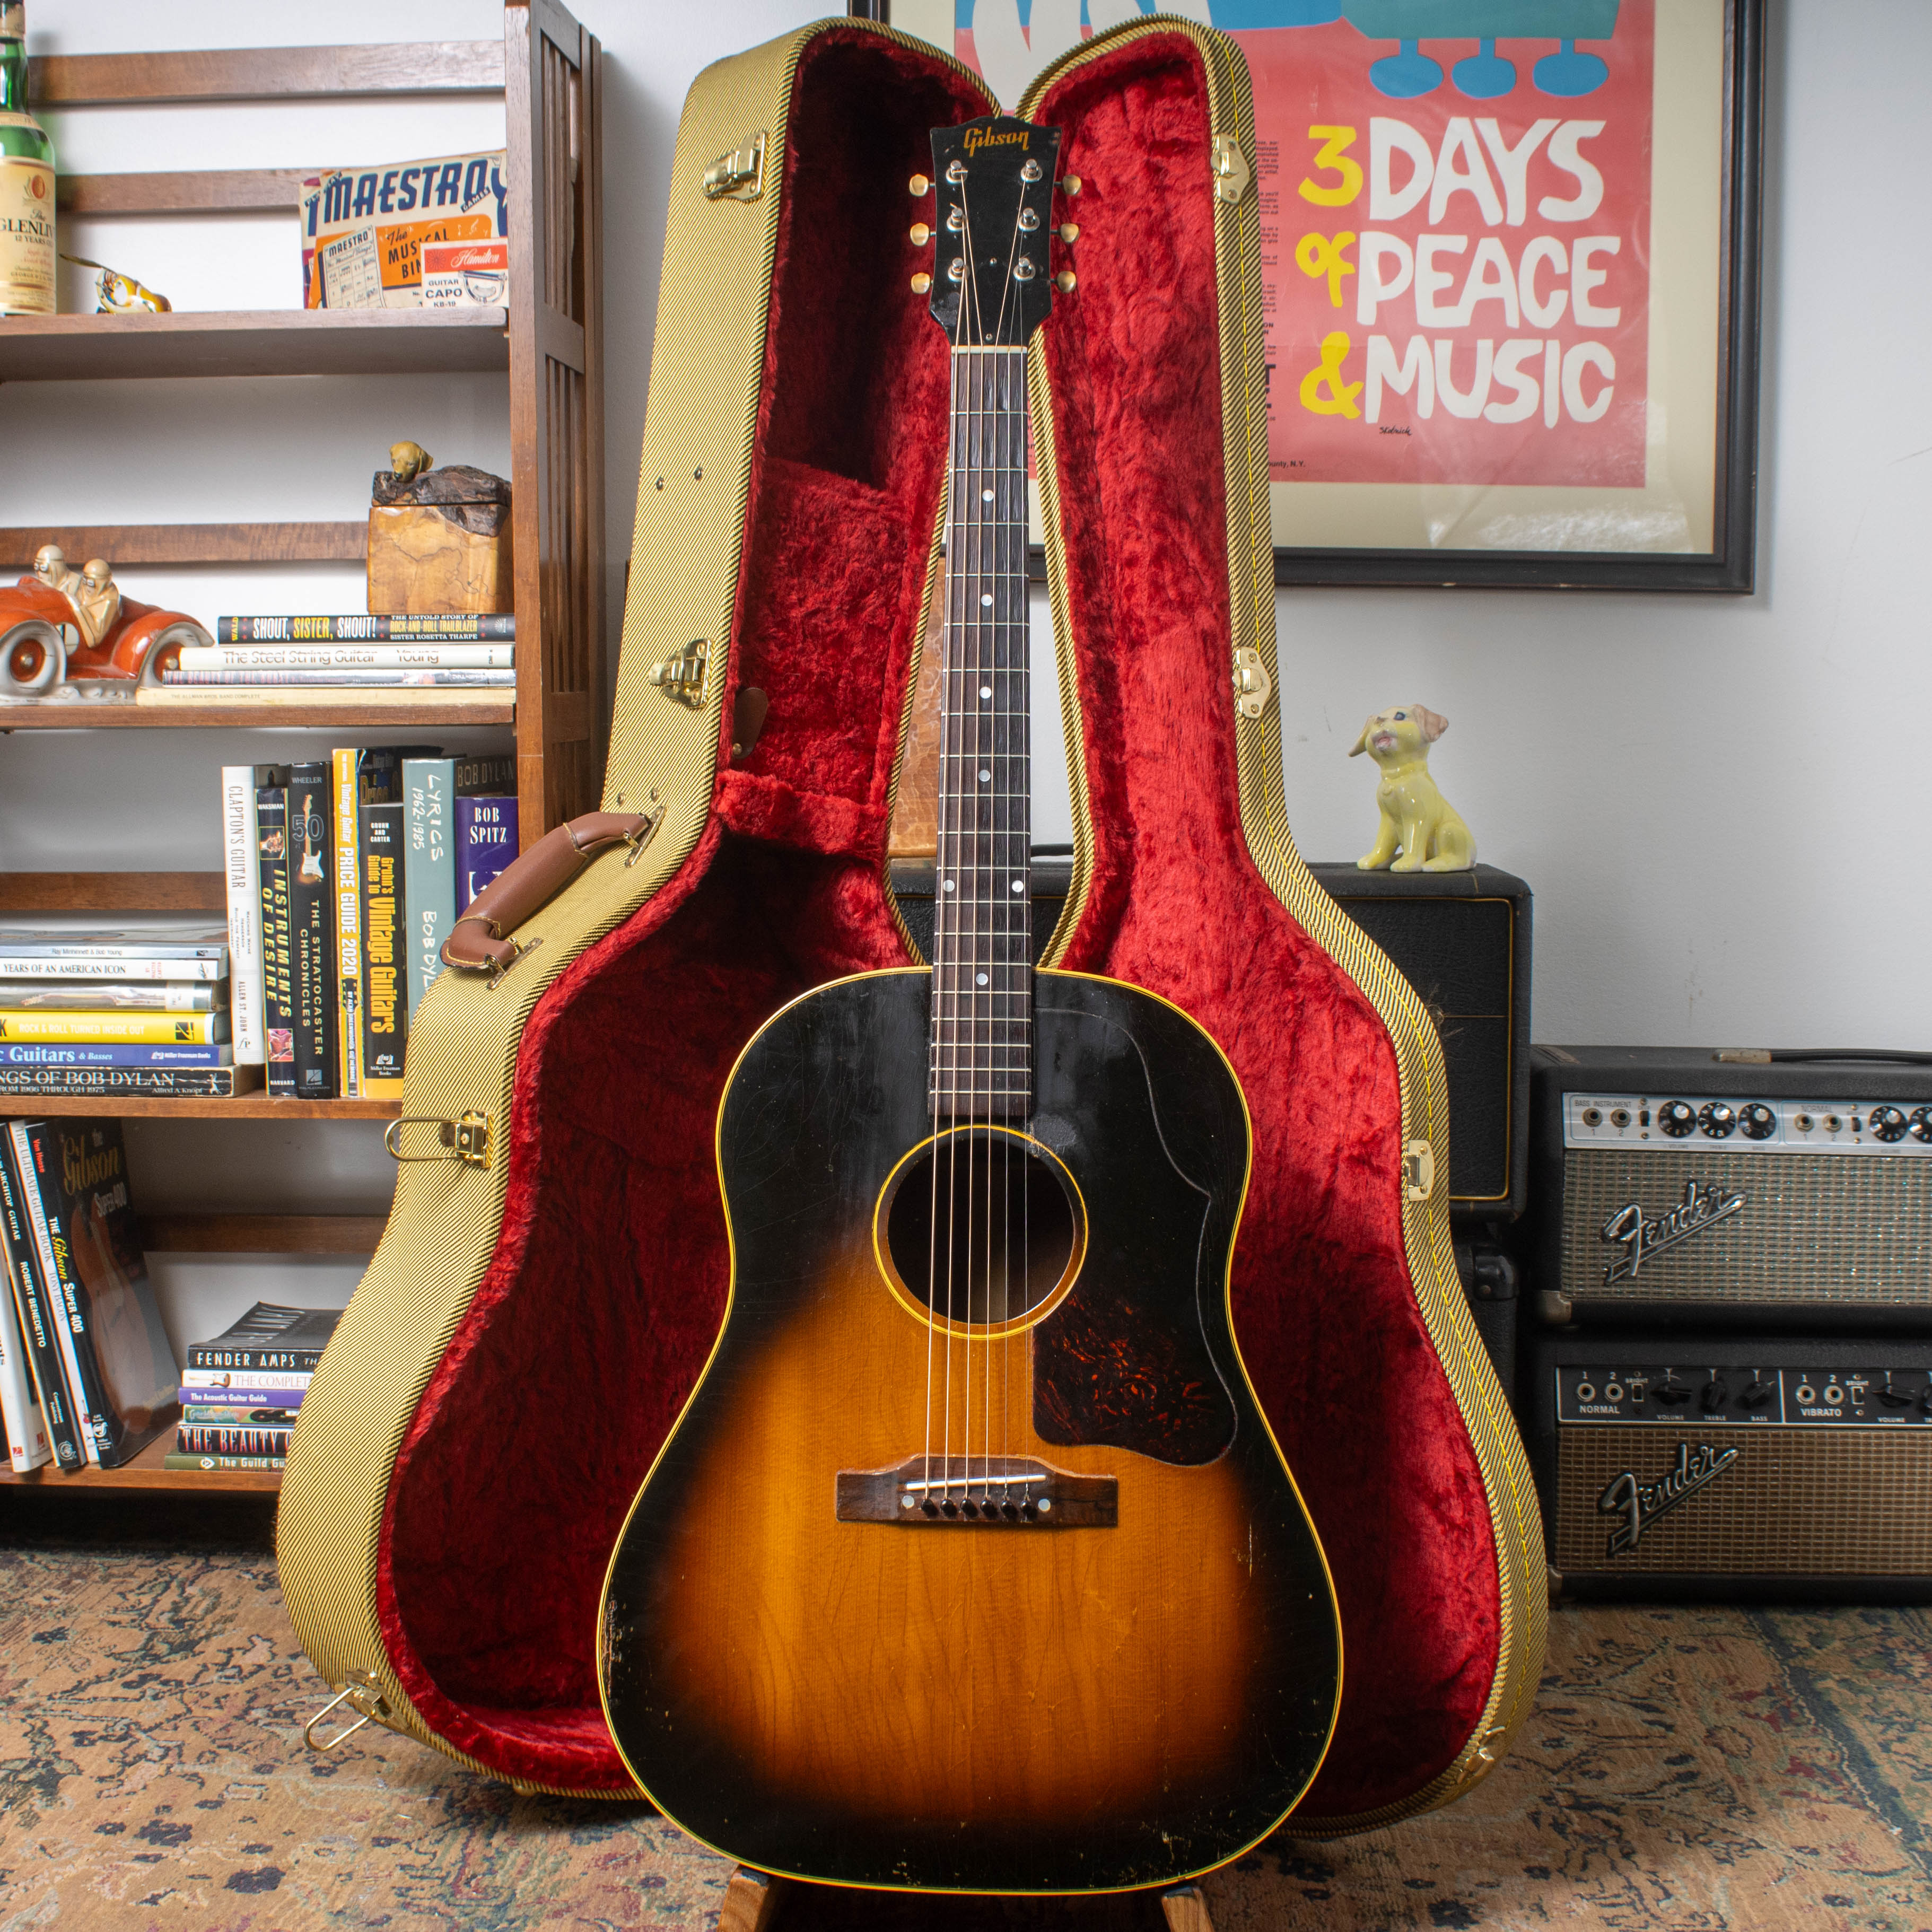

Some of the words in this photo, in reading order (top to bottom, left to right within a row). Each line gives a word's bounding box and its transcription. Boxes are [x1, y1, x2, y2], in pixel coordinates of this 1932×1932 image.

[963, 126, 1029, 158] Gibson
[1298, 125, 1363, 206] 3
[1369, 117, 1607, 226] DAYS
[387, 228, 407, 246] The
[451, 248, 500, 268] Hamilton
[425, 288, 462, 299] CAPO
[1295, 231, 1356, 308] of
[1357, 231, 1621, 329] PEACE
[1299, 331, 1364, 419] &
[1365, 334, 1616, 429] MUSIC
[253, 617, 290, 641] SHOUT,
[293, 617, 333, 640] SISTER,
[337, 616, 377, 639] SHOUT!
[390, 620, 438, 633] ROCK-AND-ROLL
[439, 620, 477, 633] TRAILBLAZER
[224, 651, 248, 664] The
[251, 651, 285, 664] Steel
[289, 650, 331, 665] String
[457, 764, 478, 788] BOB
[482, 759, 514, 783] DYLAN
[339, 783, 352, 816] Vintage
[229, 786, 244, 844] CLAPTON'S
[292, 814, 325, 842] 50
[412, 788, 426, 850] 1962-1985
[426, 774, 444, 862] LYRICS
[474, 807, 500, 823] BOB
[342, 816, 353, 844] Guitar
[470, 826, 507, 844] SPITZ
[231, 849, 246, 888] GUITAR
[339, 847, 355, 888] PRICE
[368, 855, 381, 882] Guide
[381, 857, 395, 894] Gruhn's
[263, 887, 274, 914] OF
[368, 885, 381, 894] to
[311, 900, 320, 928] THE
[340, 893, 356, 934] GUIDE
[274, 869, 292, 1018] INSTRUMENTS
[366, 897, 396, 964] Vintage
[422, 911, 438, 949] BOB
[4, 964, 29, 973] YEARS
[31, 964, 43, 973] OF
[45, 964, 57, 973] AN
[59, 964, 102, 974] AMERICAN
[104, 965, 126, 974] ICON
[263, 921, 277, 1002] DESIRE
[342, 938, 357, 975] 2020
[300, 929, 310, 1027] CHRONICLES
[312, 937, 324, 1055] STRATOCASTER
[369, 966, 397, 1033] Guitars
[19, 1023, 39, 1033] ROCK
[41, 1024, 47, 1033] &
[49, 1024, 68, 1034] ROLL
[70, 1024, 100, 1034] TURNED
[102, 1024, 128, 1035] INSIDE
[129, 1025, 144, 1035] OUT
[9, 1046, 75, 1062] Guitars
[36, 1071, 61, 1085] OF
[66, 1071, 105, 1085] BOB
[110, 1071, 175, 1086] DYLAN
[1618, 1129, 1624, 1137] 2
[64, 1134, 119, 1196] Gibson
[21, 1148, 39, 1196] ULTIMATE
[31, 1197, 47, 1232] GUITAR
[40, 1234, 53, 1263] BOOK
[8, 1210, 21, 1241] GUITAR
[49, 1216, 61, 1235] THE
[1601, 1181, 1747, 1286] Fender
[51, 1236, 68, 1280] Gibson
[20, 1261, 35, 1296] ROBERT
[28, 1297, 47, 1348] BENEDETTO
[63, 1282, 78, 1313] SUPER
[70, 1314, 84, 1333] 400
[196, 1352, 251, 1367] FENDER
[259, 1353, 296, 1367] AMPS
[234, 1375, 256, 1387] THE
[1582, 1371, 1588, 1379] 1
[1802, 1374, 1808, 1383] 1
[1830, 1375, 1837, 1383] 2
[191, 1393, 203, 1401] The
[204, 1393, 228, 1402] Acoustic
[229, 1393, 248, 1402] Guitar
[249, 1394, 268, 1402] Guide
[1579, 1404, 1621, 1415] NORMAL
[1800, 1408, 1842, 1417] VIBRATO
[182, 1429, 212, 1452] THE
[220, 1429, 278, 1453] BEAUTY
[219, 1456, 237, 1467] The
[241, 1457, 268, 1467] Guild
[1598, 1443, 1739, 1557] Fender
